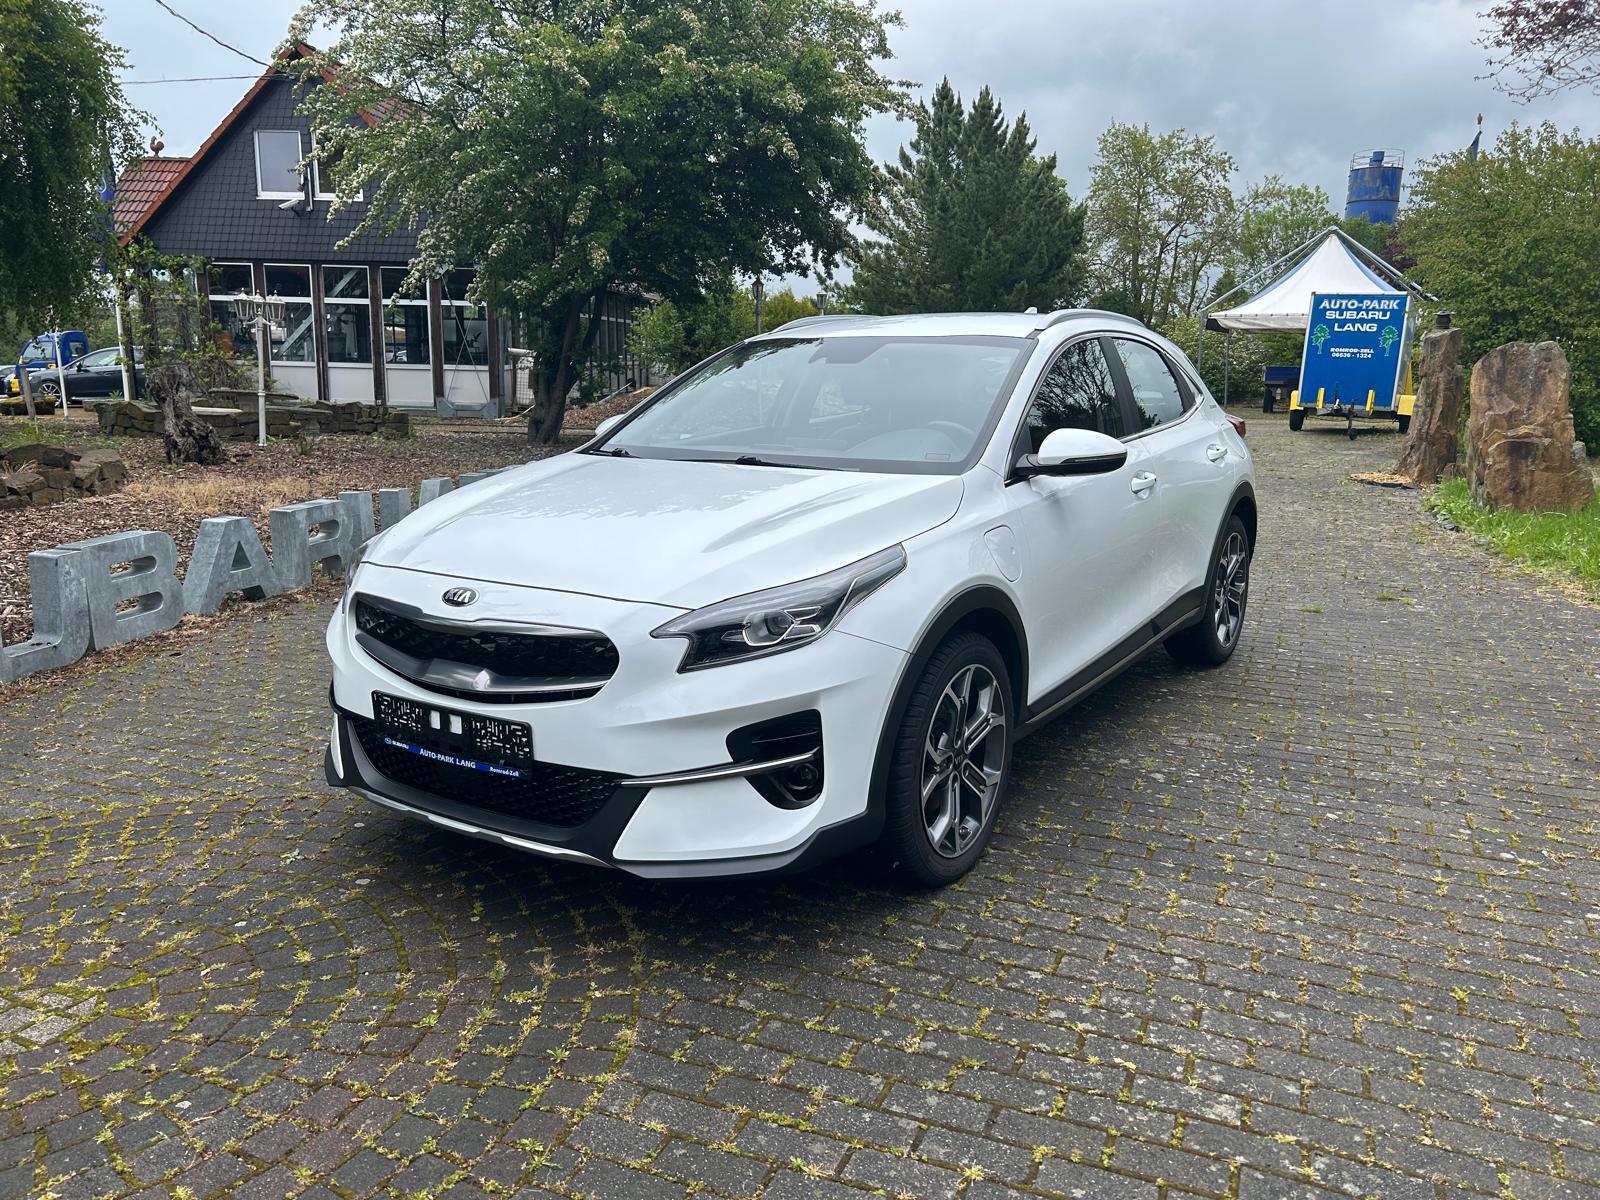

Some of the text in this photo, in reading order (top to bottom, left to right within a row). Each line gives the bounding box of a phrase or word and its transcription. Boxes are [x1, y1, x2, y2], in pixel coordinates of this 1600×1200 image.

[1319, 299, 1400, 309] AUTO-PARK
[1325, 311, 1390, 319] SUBARU
[1334, 323, 1377, 331] LANG
[445, 588, 472, 603] KIA
[419, 749, 454, 764] AUTO-PARK
[456, 758, 476, 769] LANG
